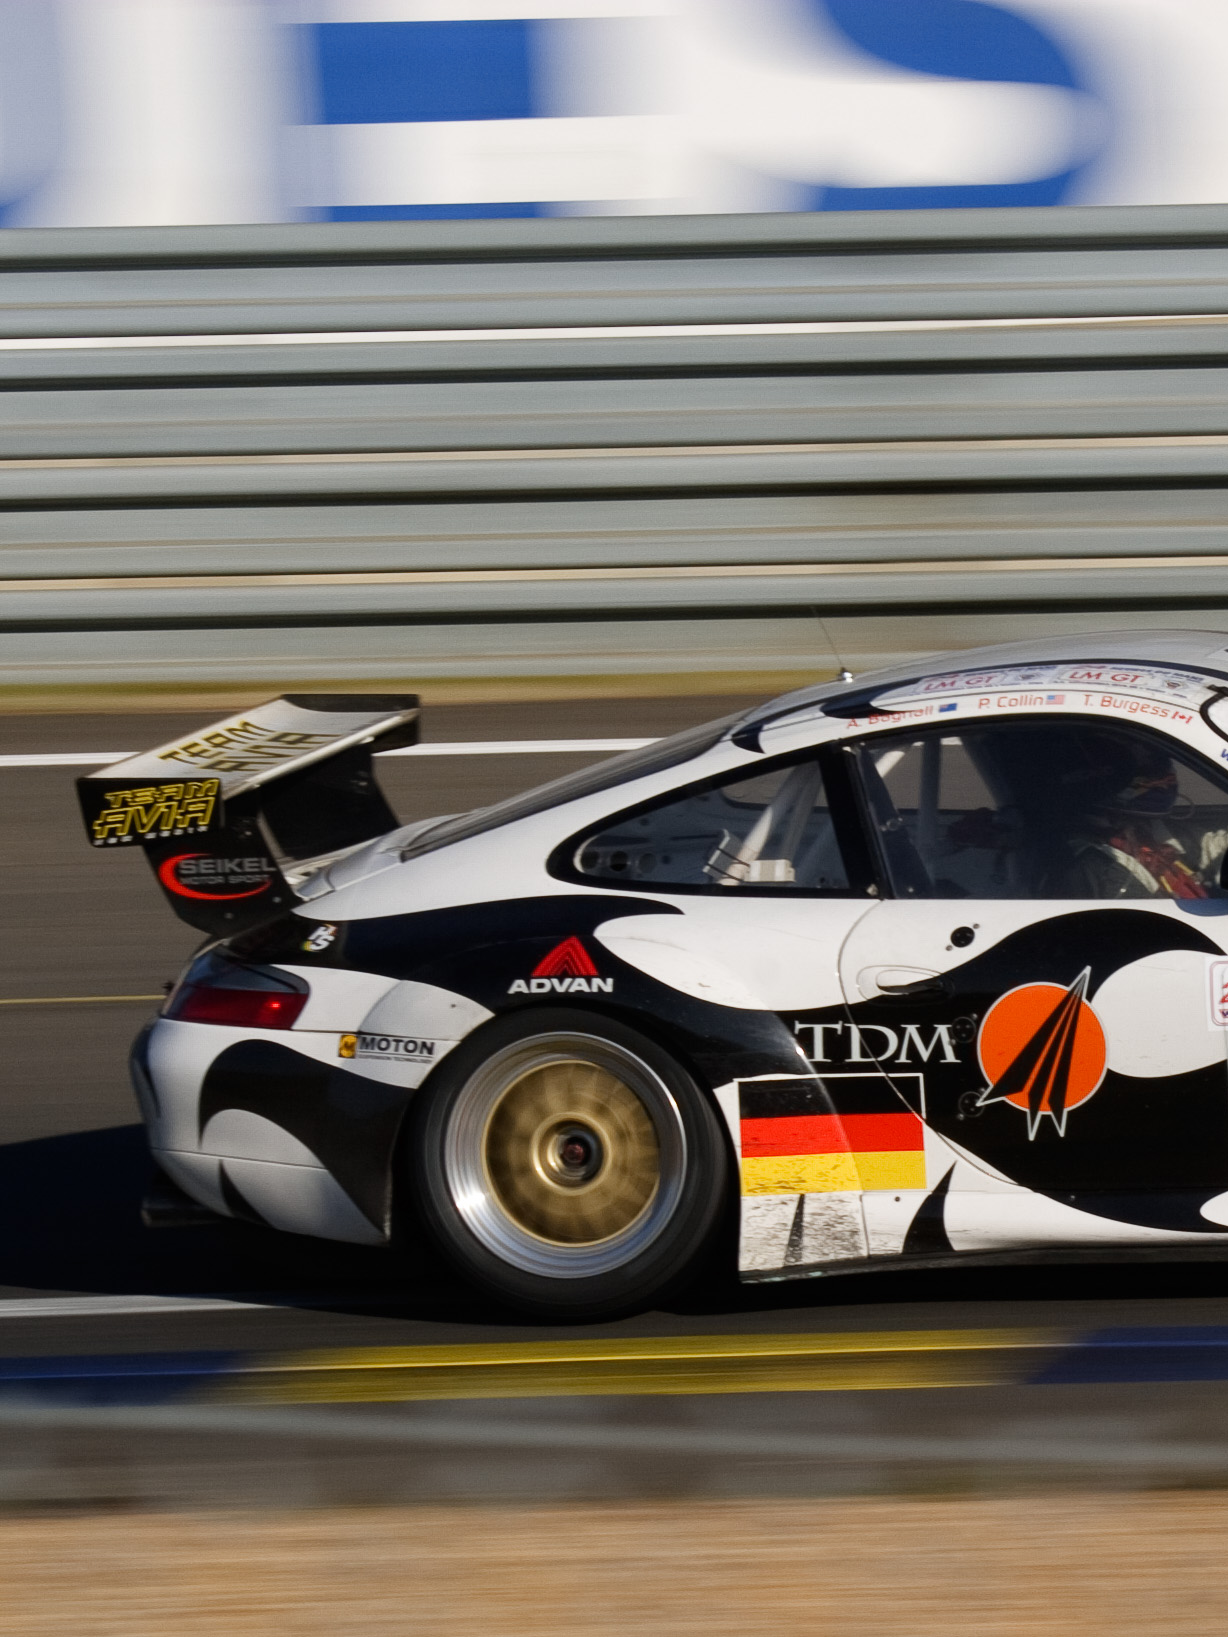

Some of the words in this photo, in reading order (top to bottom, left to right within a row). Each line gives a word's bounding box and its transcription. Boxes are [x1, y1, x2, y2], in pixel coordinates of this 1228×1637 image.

[1069, 671, 1102, 680] LM
[1111, 673, 1144, 683] GT
[997, 695, 1044, 709] Collin
[1100, 695, 1170, 718] Burgess
[180, 857, 277, 876] SEIKEL
[507, 977, 615, 995] ADVAN
[359, 1036, 435, 1056] MOTON
[793, 1020, 961, 1064] TDM
